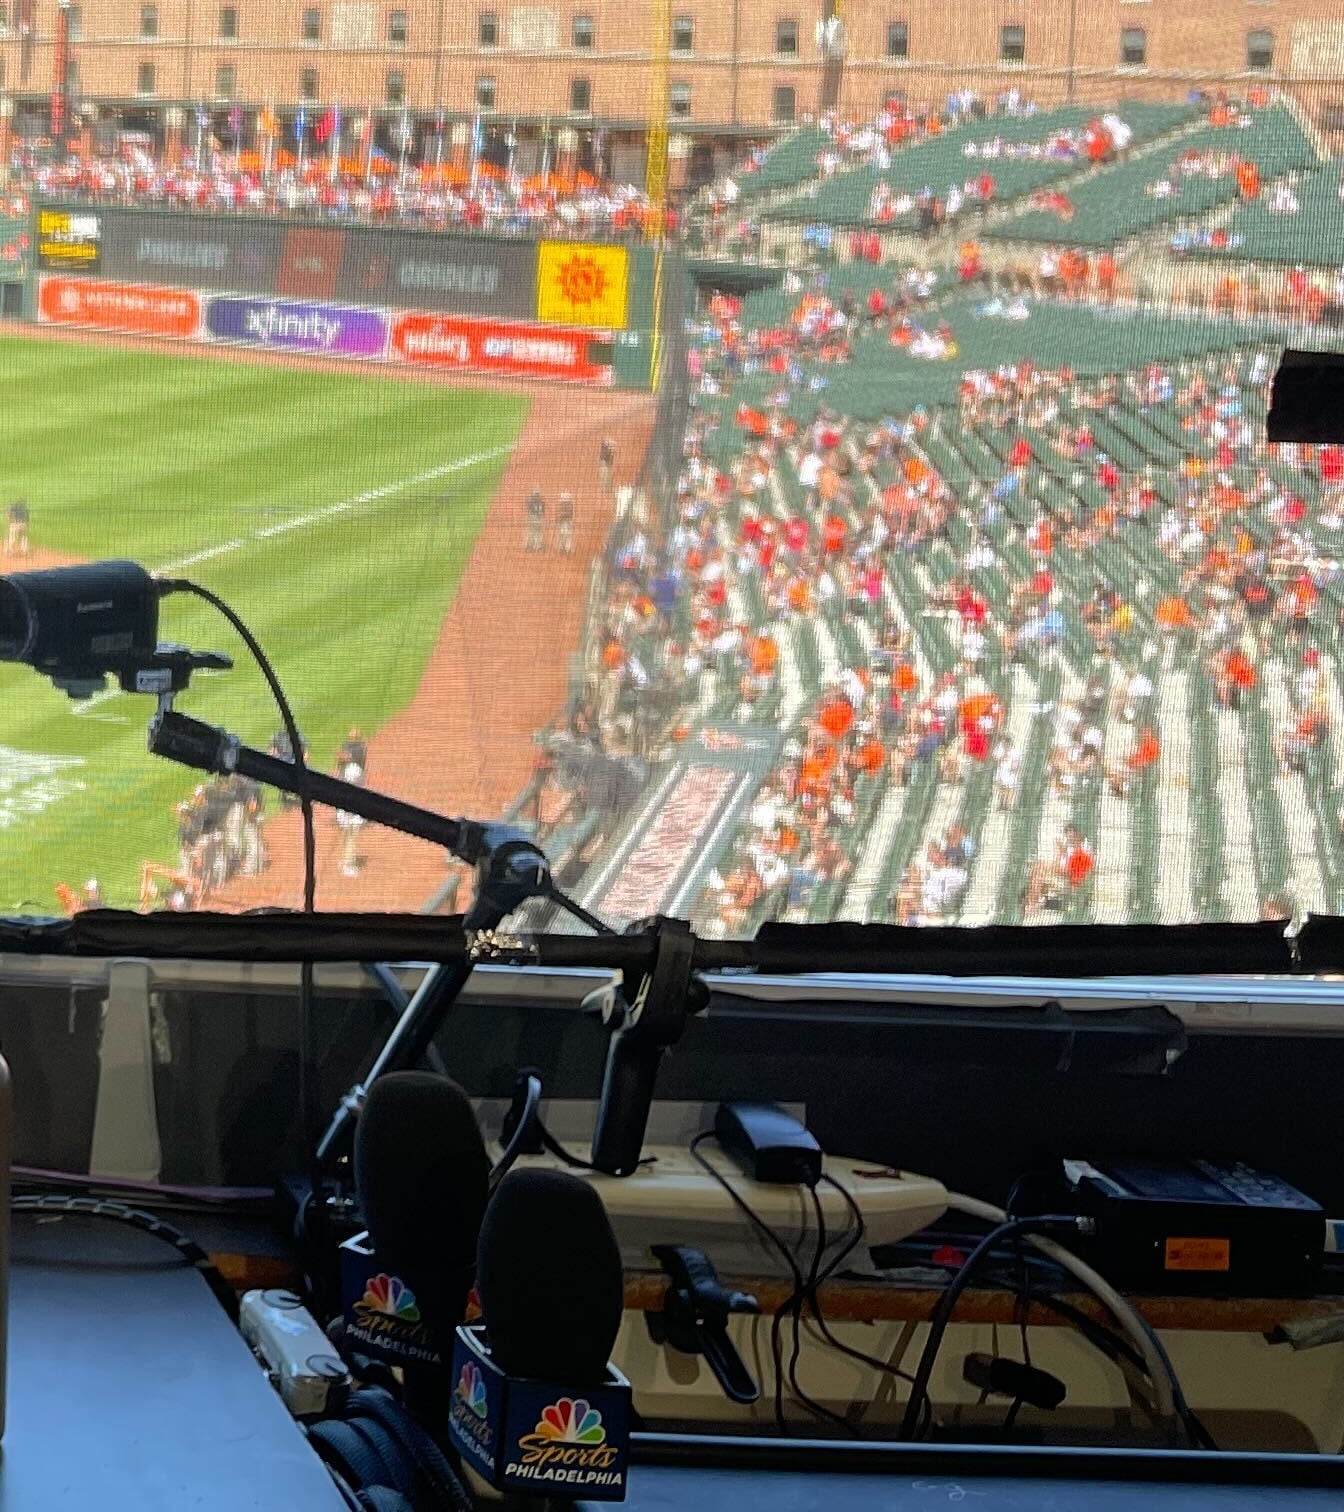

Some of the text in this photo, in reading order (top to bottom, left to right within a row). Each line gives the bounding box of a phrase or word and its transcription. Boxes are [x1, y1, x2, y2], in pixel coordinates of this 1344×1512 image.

[246, 303, 340, 349] xfinity
[518, 1432, 618, 1469] Sports
[505, 1462, 622, 1486] PHILADELPHIA
